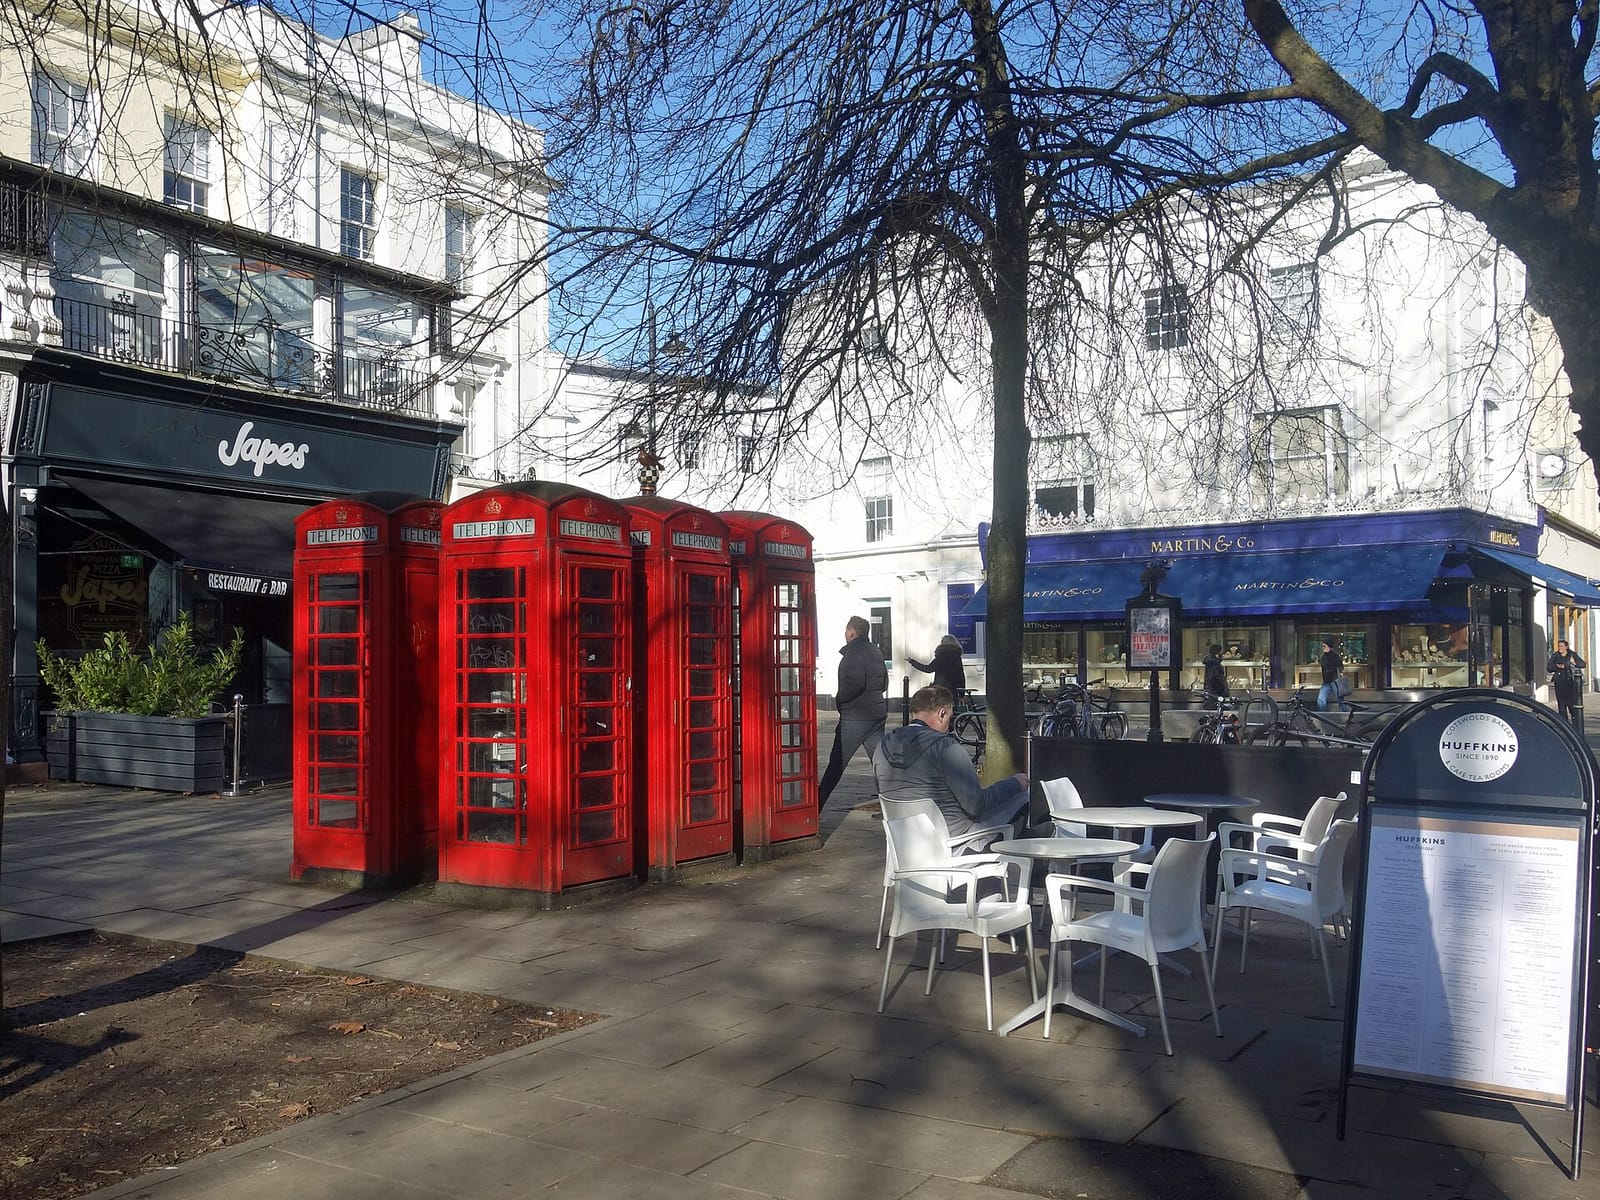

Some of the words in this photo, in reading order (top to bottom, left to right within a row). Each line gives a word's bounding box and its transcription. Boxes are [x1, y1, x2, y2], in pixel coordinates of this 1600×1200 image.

[218, 421, 309, 477] Japes
[309, 527, 376, 543] TELEPHONE
[456, 519, 532, 537] TELEPHONE
[562, 521, 618, 539] TELEPHONE
[673, 533, 720, 549] TELEPHONE
[765, 542, 804, 557] TELEPHONE
[1151, 538, 1211, 552] MARTIN
[1214, 535, 1233, 552] &
[1236, 536, 1255, 548] Co
[92, 563, 121, 575] PIZZA
[60, 565, 148, 613] Japes
[208, 573, 261, 594] RESTAURANT
[261, 582, 268, 594] &
[269, 580, 288, 595] BAR
[1023, 587, 1102, 598] ARTIN&CO
[1446, 715, 1490, 736] COTSWOLDS
[1491, 718, 1514, 739] BAKERY
[1442, 741, 1516, 753] HUFFKINS
[1485, 763, 1510, 780] ROOMS
[1395, 835, 1446, 845] HUFFKINS
